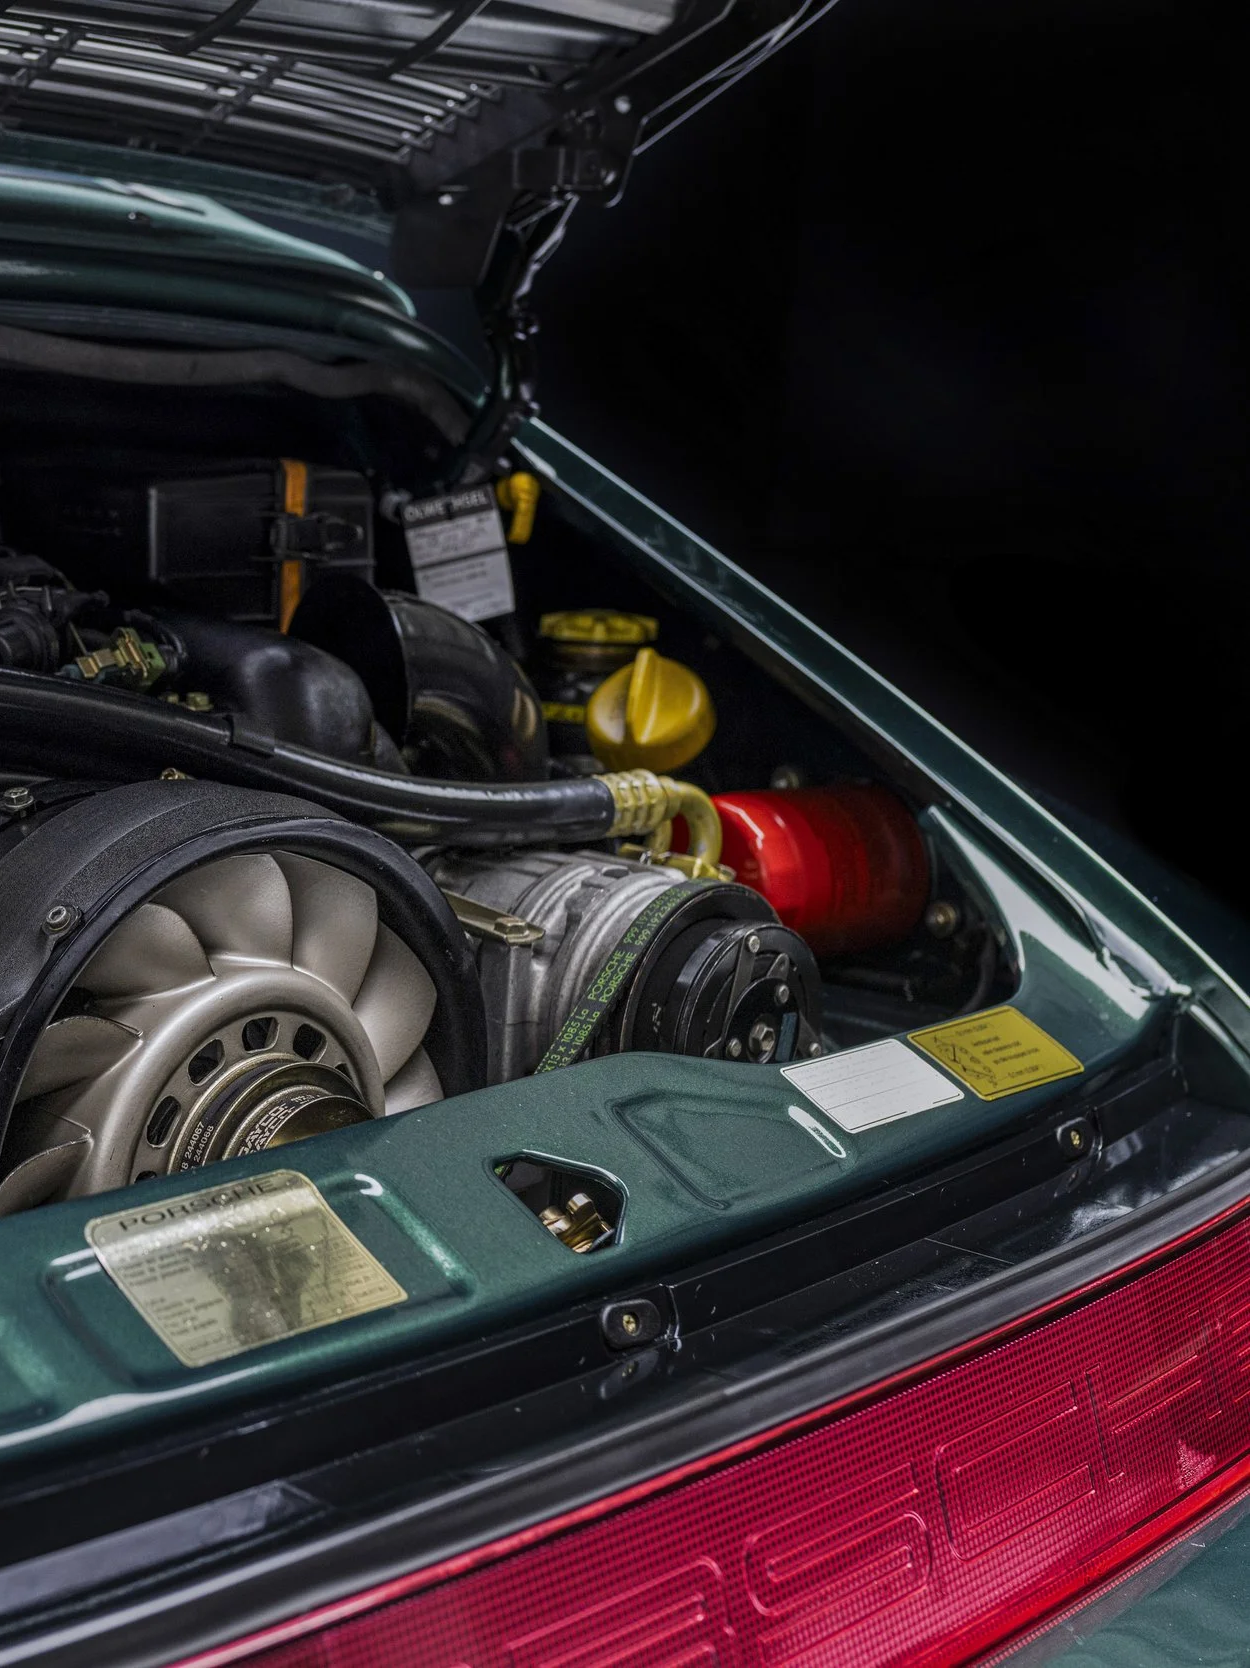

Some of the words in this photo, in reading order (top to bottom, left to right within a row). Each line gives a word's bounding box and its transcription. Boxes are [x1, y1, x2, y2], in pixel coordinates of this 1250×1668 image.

[561, 1021, 580, 1043] 1085
[588, 950, 624, 1001] PORSCHE
[573, 1024, 592, 1045] 1085
[599, 951, 637, 1003] PORSCHE
[185, 1121, 205, 1159] 244067
[118, 1178, 279, 1231] PORSCHE
